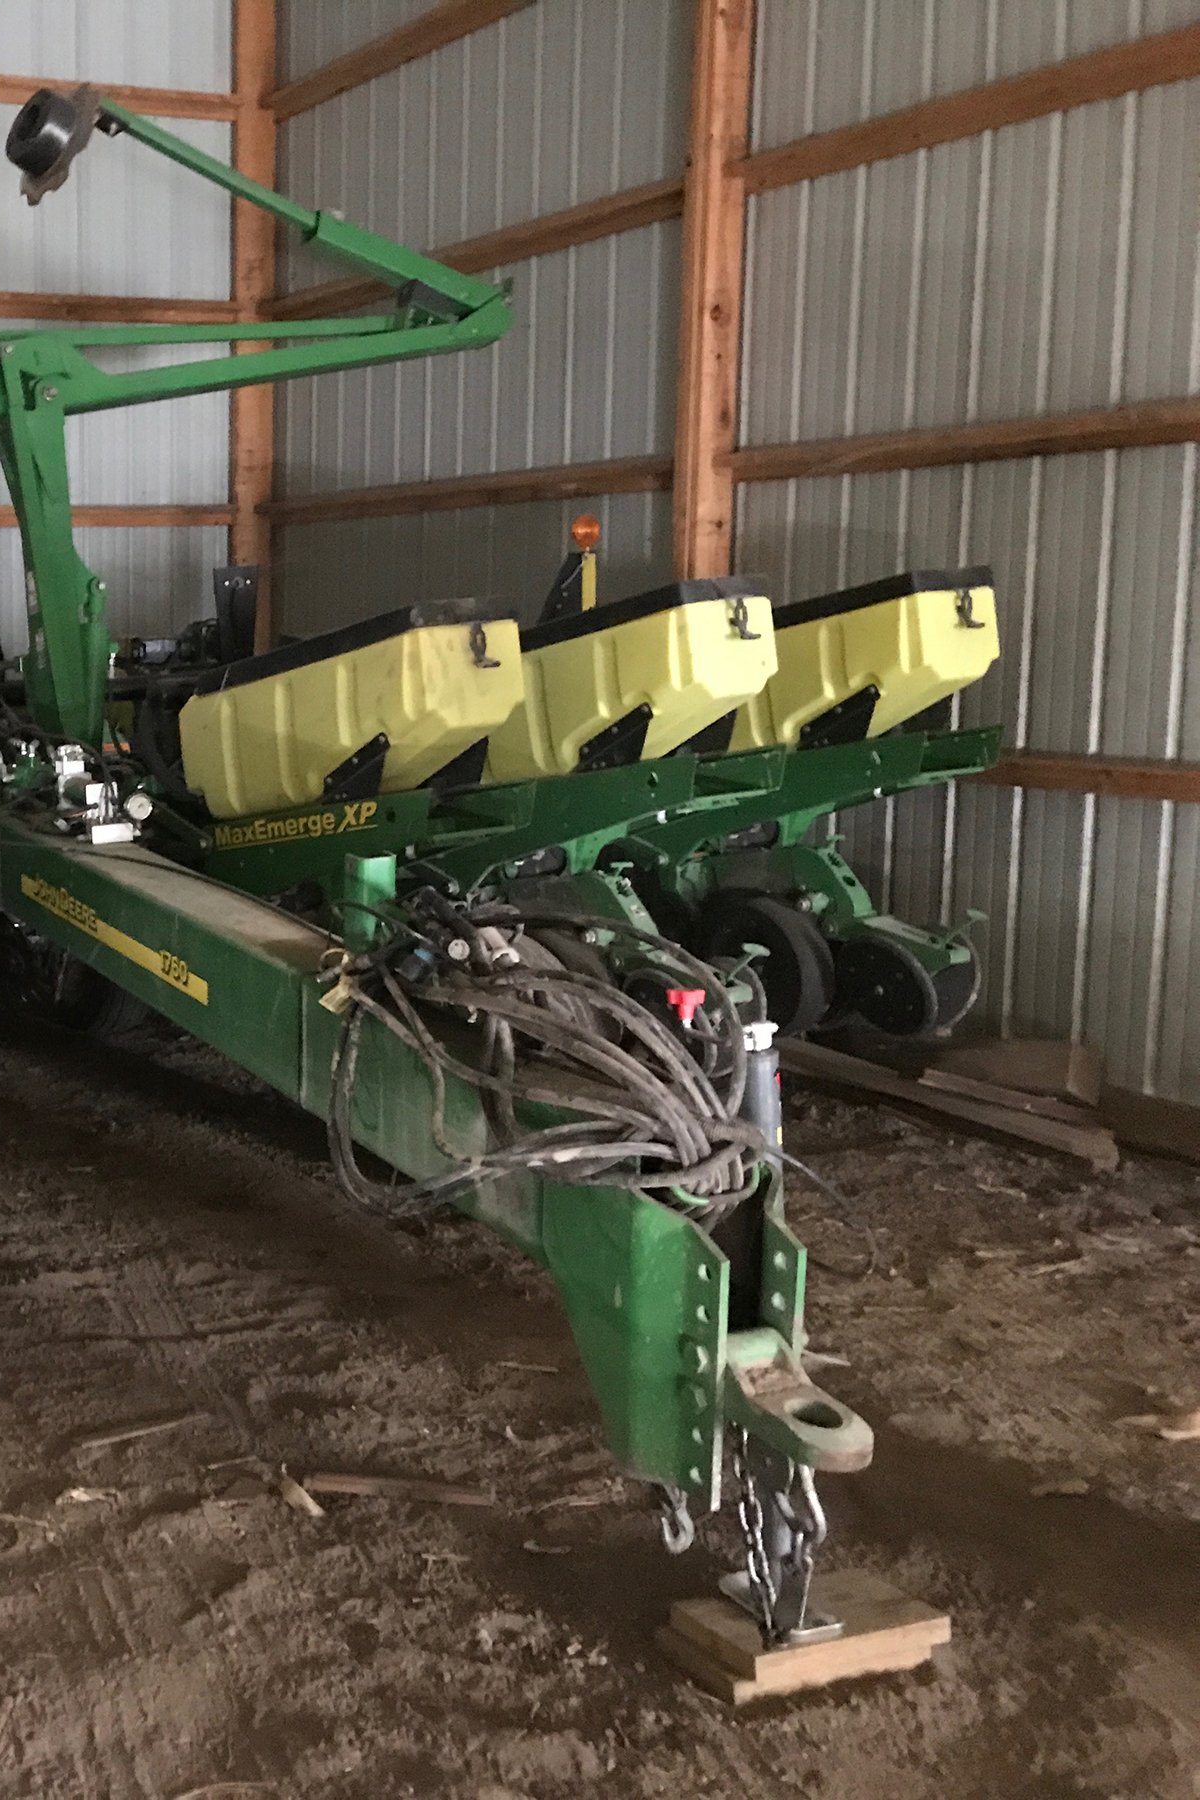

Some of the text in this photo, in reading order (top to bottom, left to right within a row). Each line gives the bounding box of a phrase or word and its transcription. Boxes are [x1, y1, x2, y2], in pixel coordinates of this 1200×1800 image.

[215, 801, 378, 847] MaxEmerge XP
[59, 887, 98, 931] DEERE
